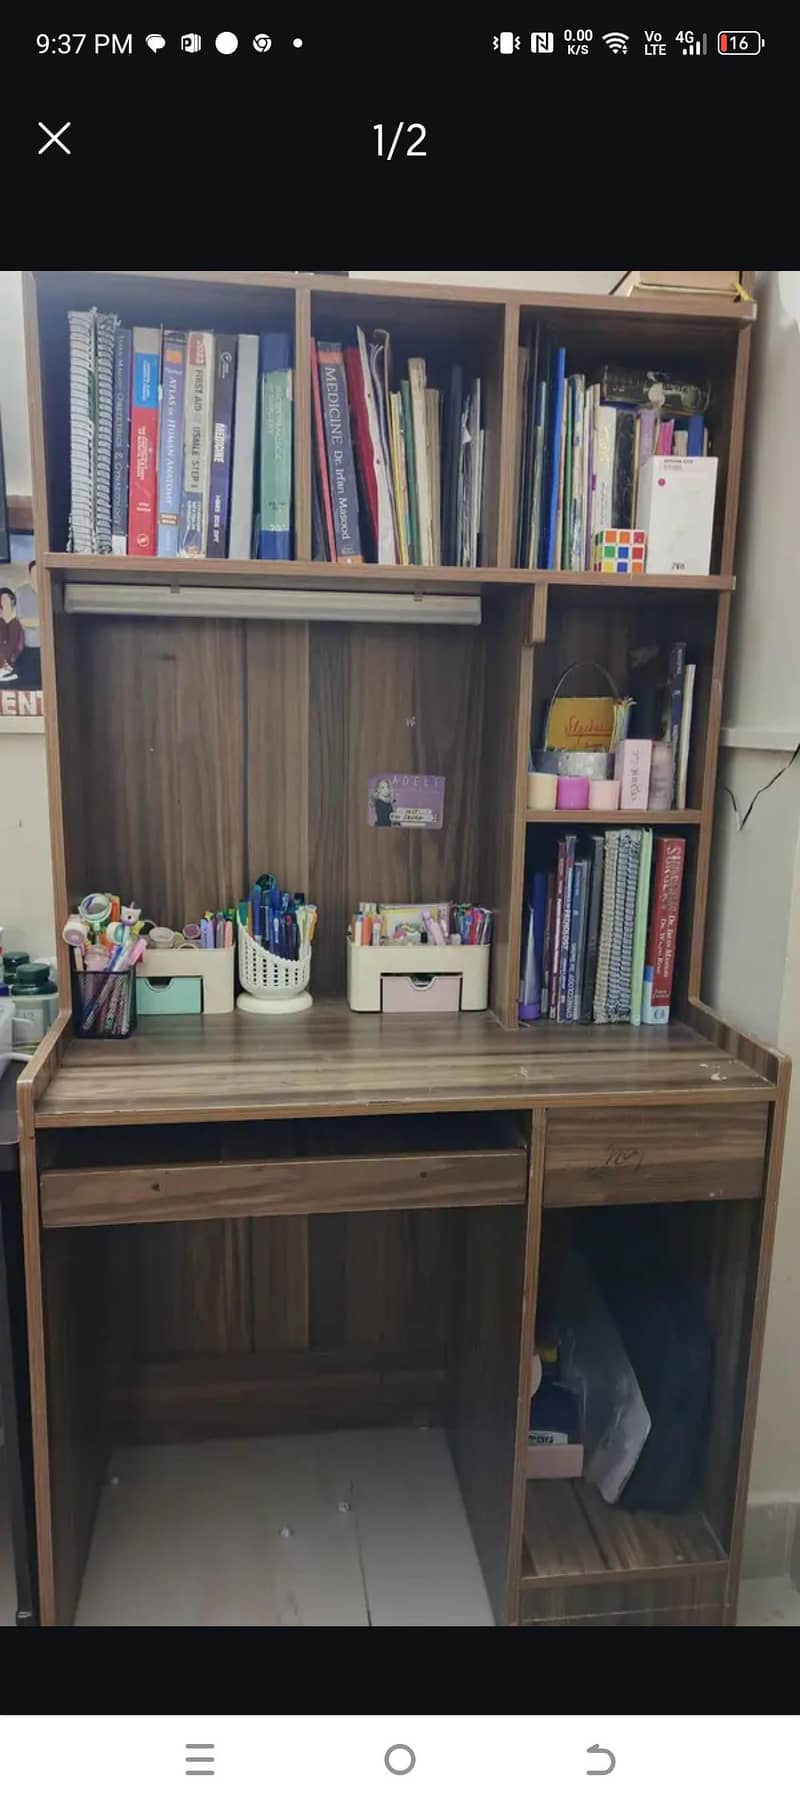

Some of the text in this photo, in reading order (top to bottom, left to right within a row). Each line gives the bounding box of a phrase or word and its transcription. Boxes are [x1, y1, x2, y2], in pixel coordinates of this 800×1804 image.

[167, 377, 177, 406] ATLAS
[194, 369, 204, 394] FIRST
[194, 396, 203, 411] AID
[167, 419, 177, 456] HUMAN
[191, 427, 201, 456] USMLE
[214, 423, 225, 464] MEDICINE
[325, 367, 351, 540] MEDICINE Dr. Irfan Masood
[165, 457, 176, 504] ANATOMY
[191, 460, 200, 481] STEP
